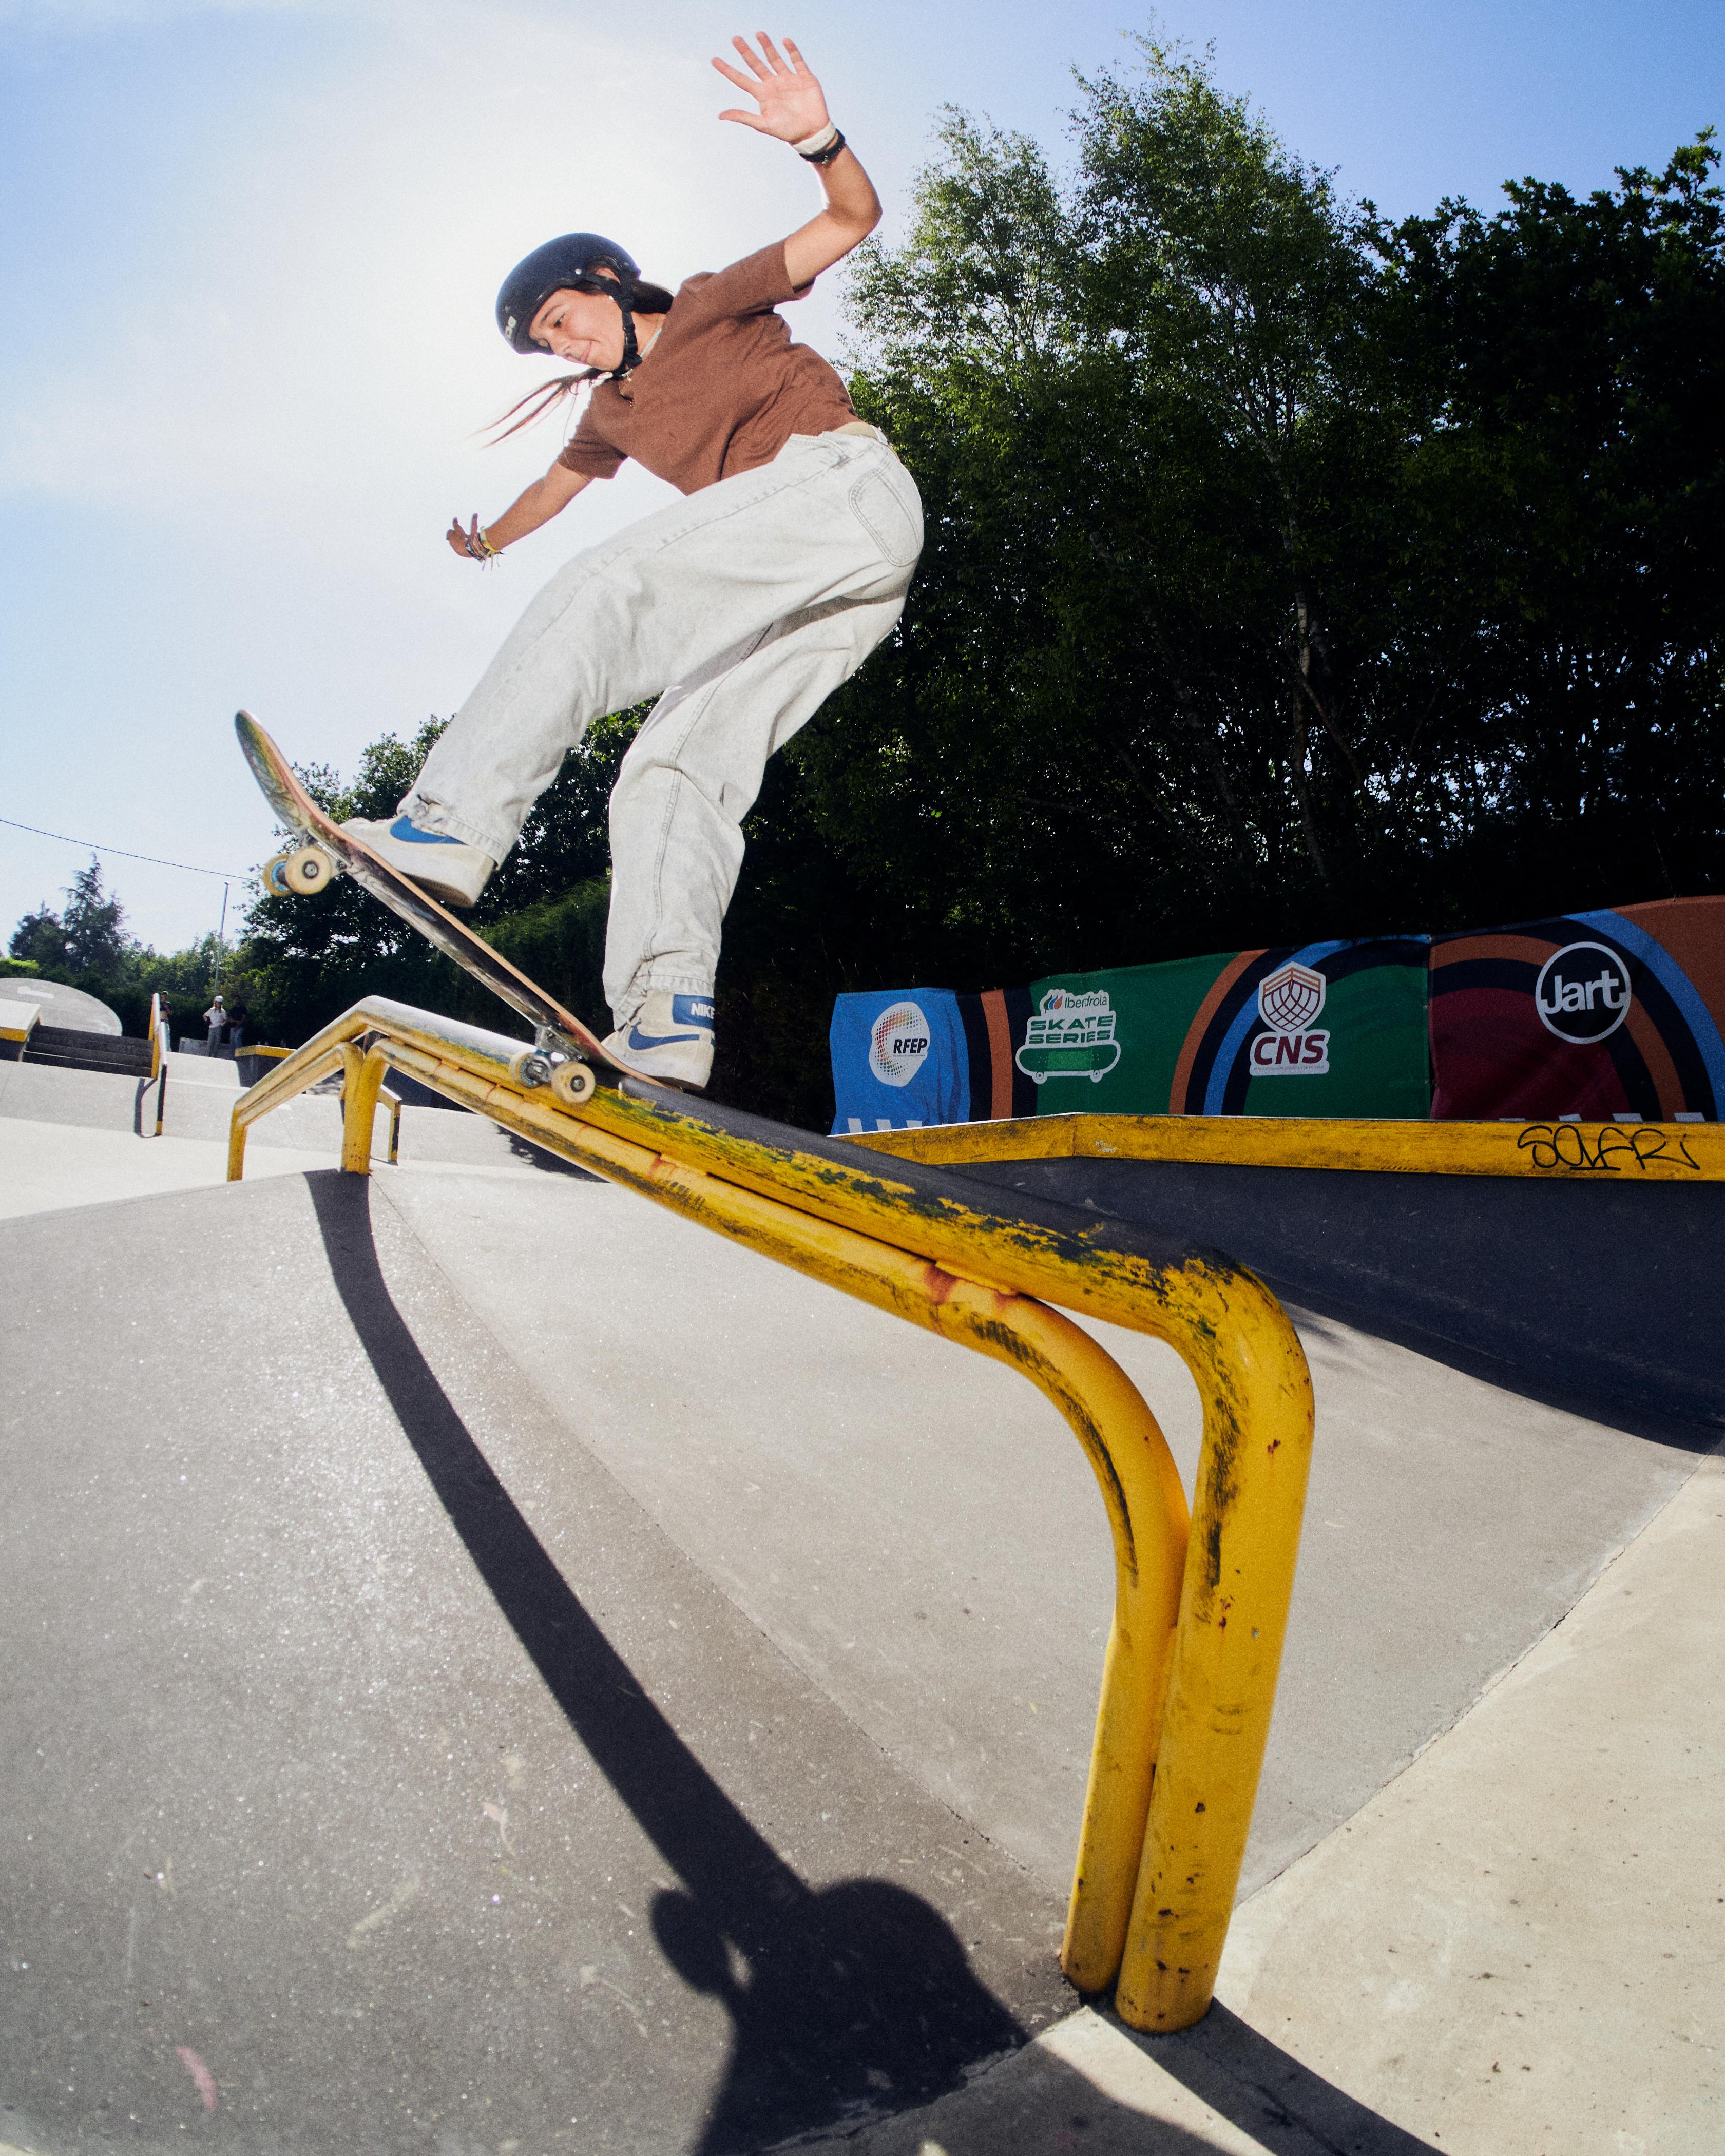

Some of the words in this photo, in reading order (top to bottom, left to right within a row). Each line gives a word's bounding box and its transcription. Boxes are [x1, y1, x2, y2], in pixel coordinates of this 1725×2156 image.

[1541, 970, 1626, 1014] Jart
[1064, 995, 1107, 1008] Iberdrola
[1030, 1015, 1114, 1031] SKATE
[1028, 1030, 1111, 1044] SERIES
[893, 1038, 928, 1054] RFEP
[1253, 1034, 1326, 1065] CNS
